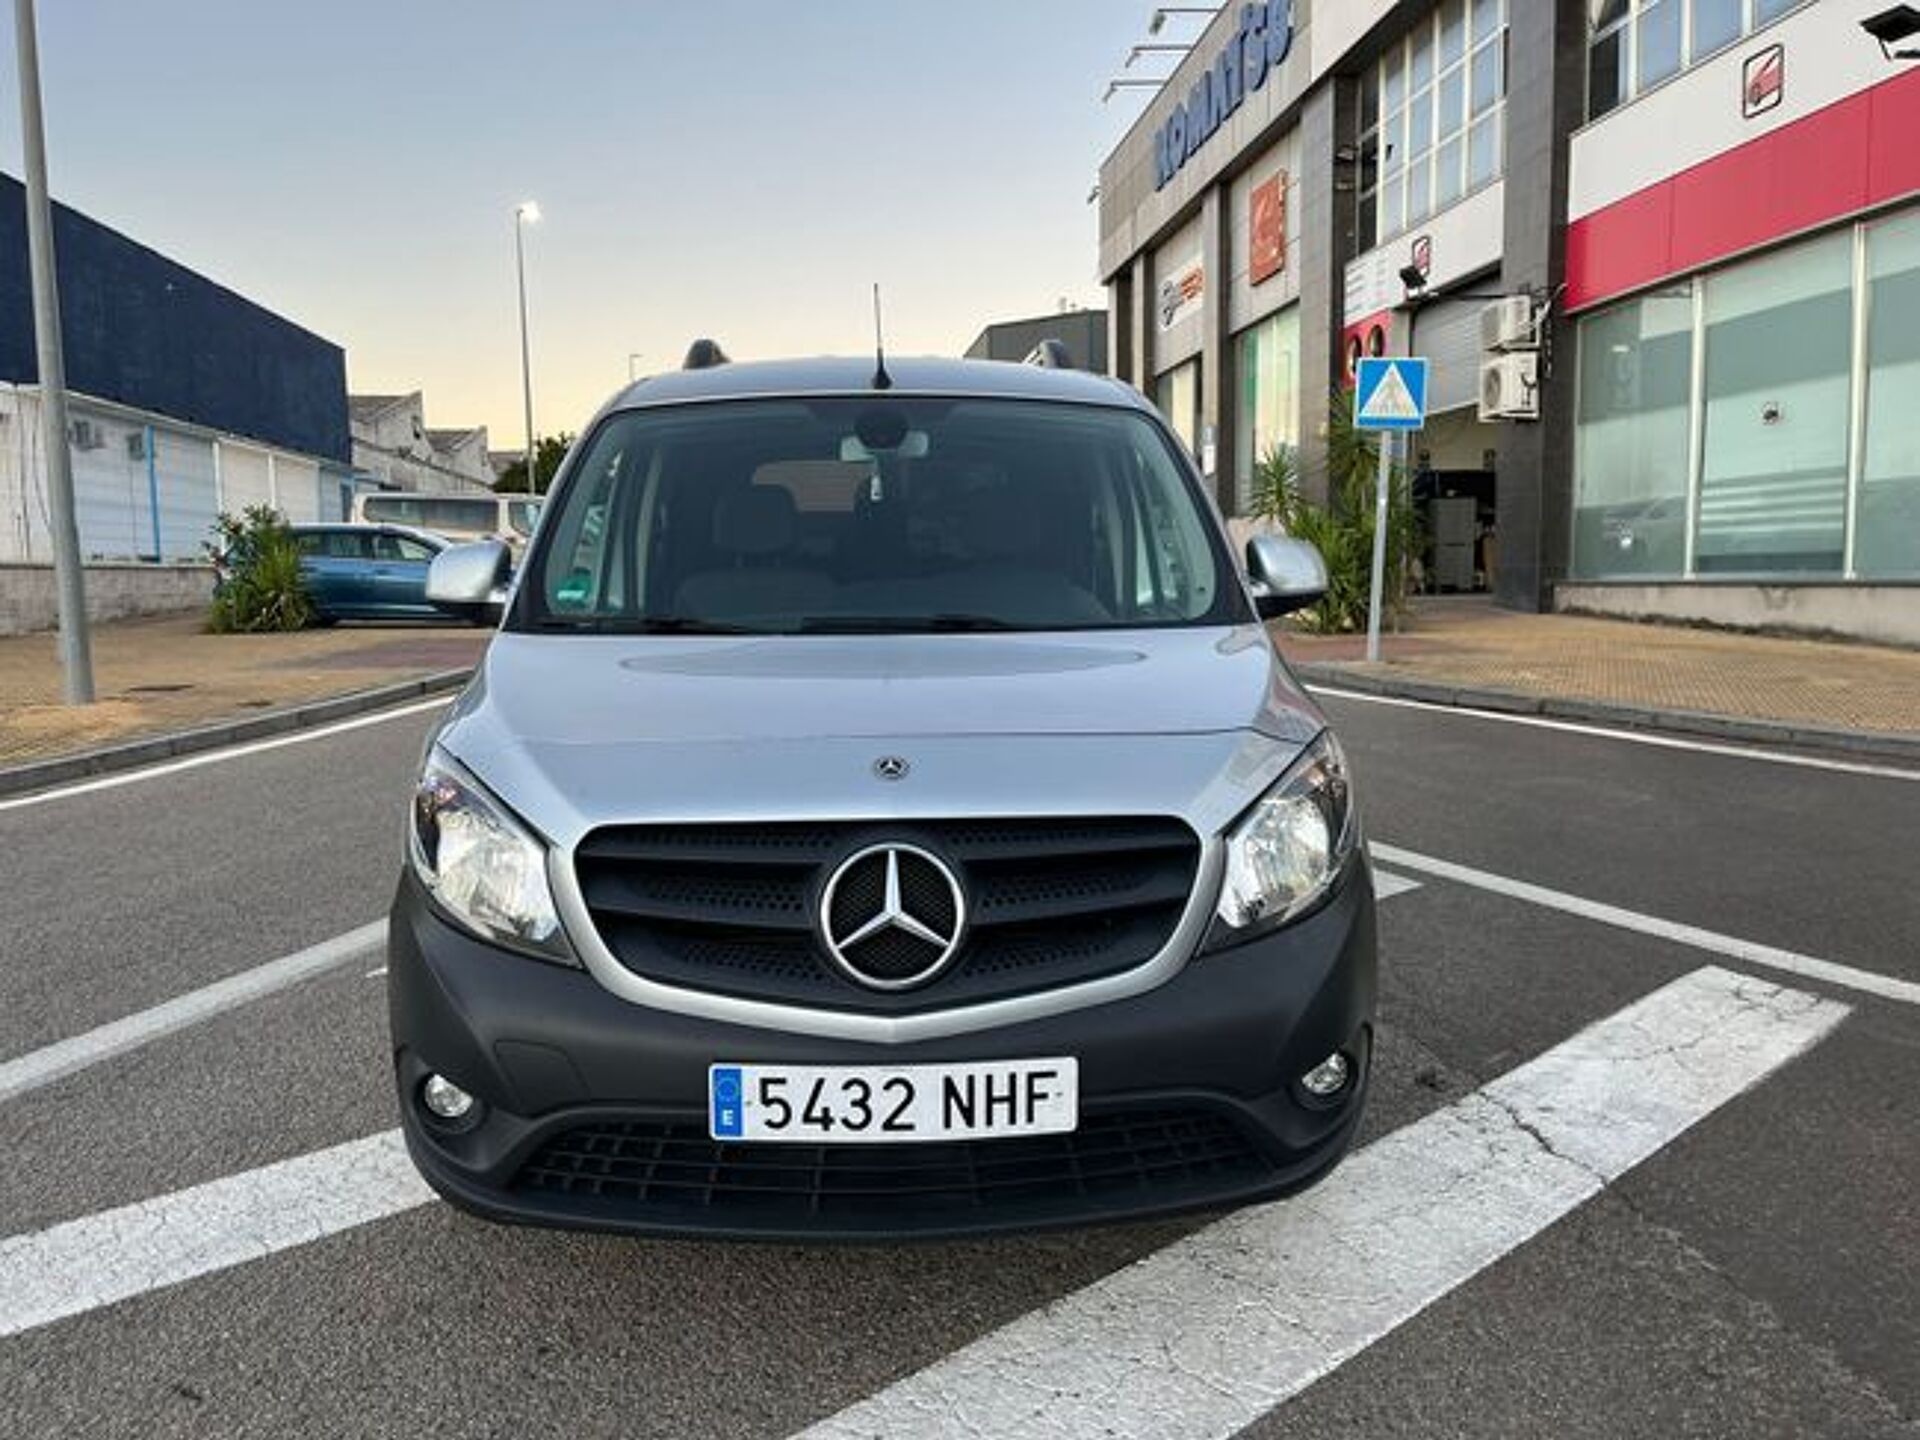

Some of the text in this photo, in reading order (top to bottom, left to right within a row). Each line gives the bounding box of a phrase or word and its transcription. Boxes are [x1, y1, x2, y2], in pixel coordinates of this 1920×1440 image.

[722, 1109, 734, 1126] E
[759, 1071, 1057, 1131] 5432 NHF
